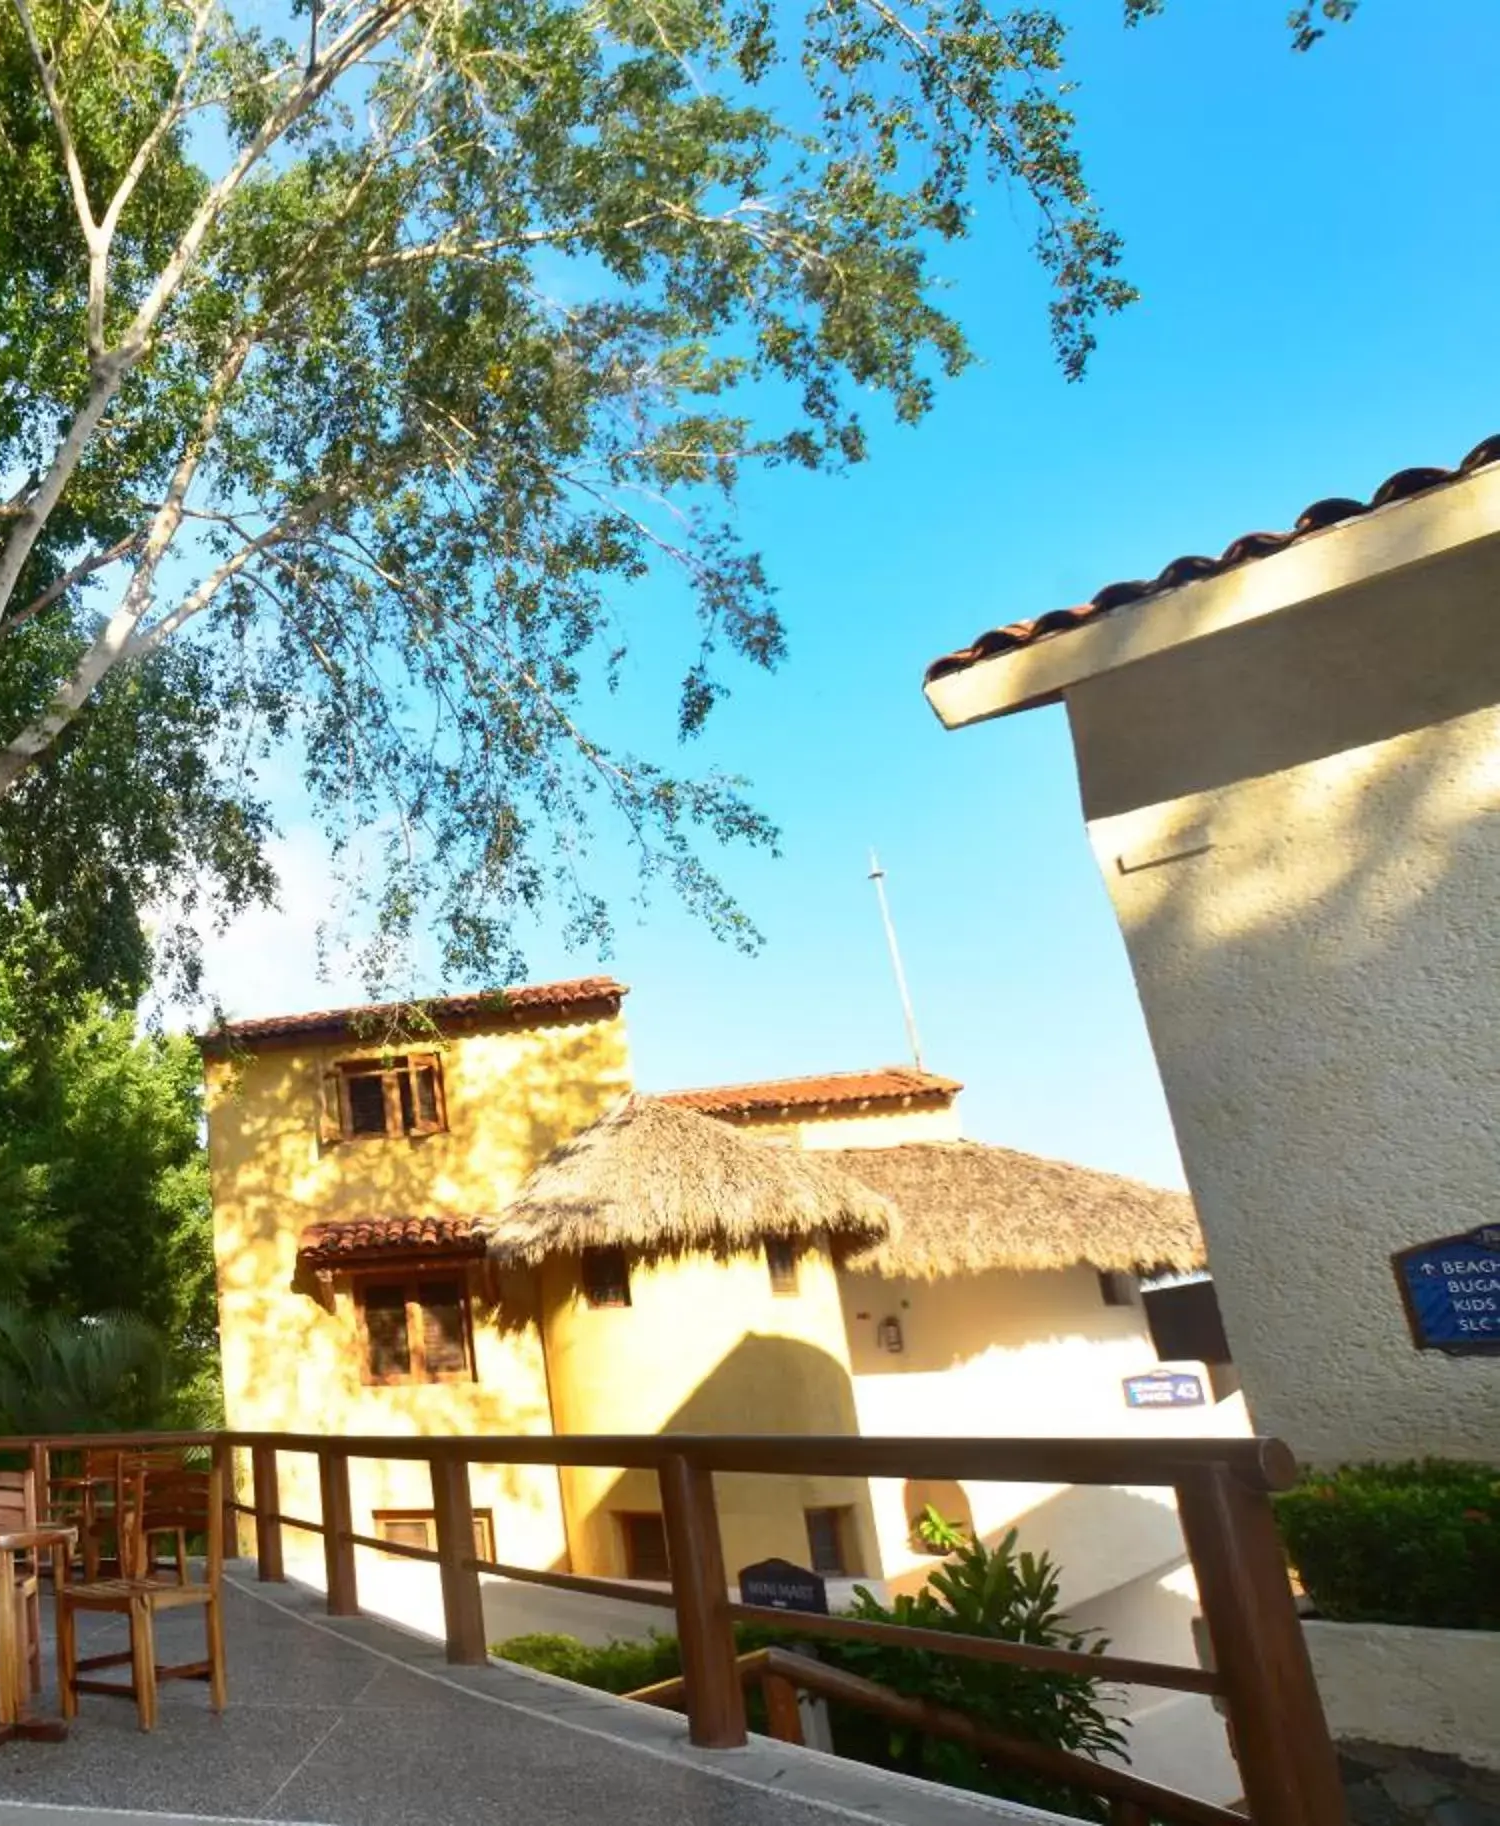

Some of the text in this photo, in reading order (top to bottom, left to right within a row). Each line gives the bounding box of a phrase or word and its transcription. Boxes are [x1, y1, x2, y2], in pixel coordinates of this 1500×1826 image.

[1441, 1259, 1500, 1275] BEACH
[1452, 1298, 1497, 1312] KIDS
[1458, 1317, 1493, 1331] SLC
